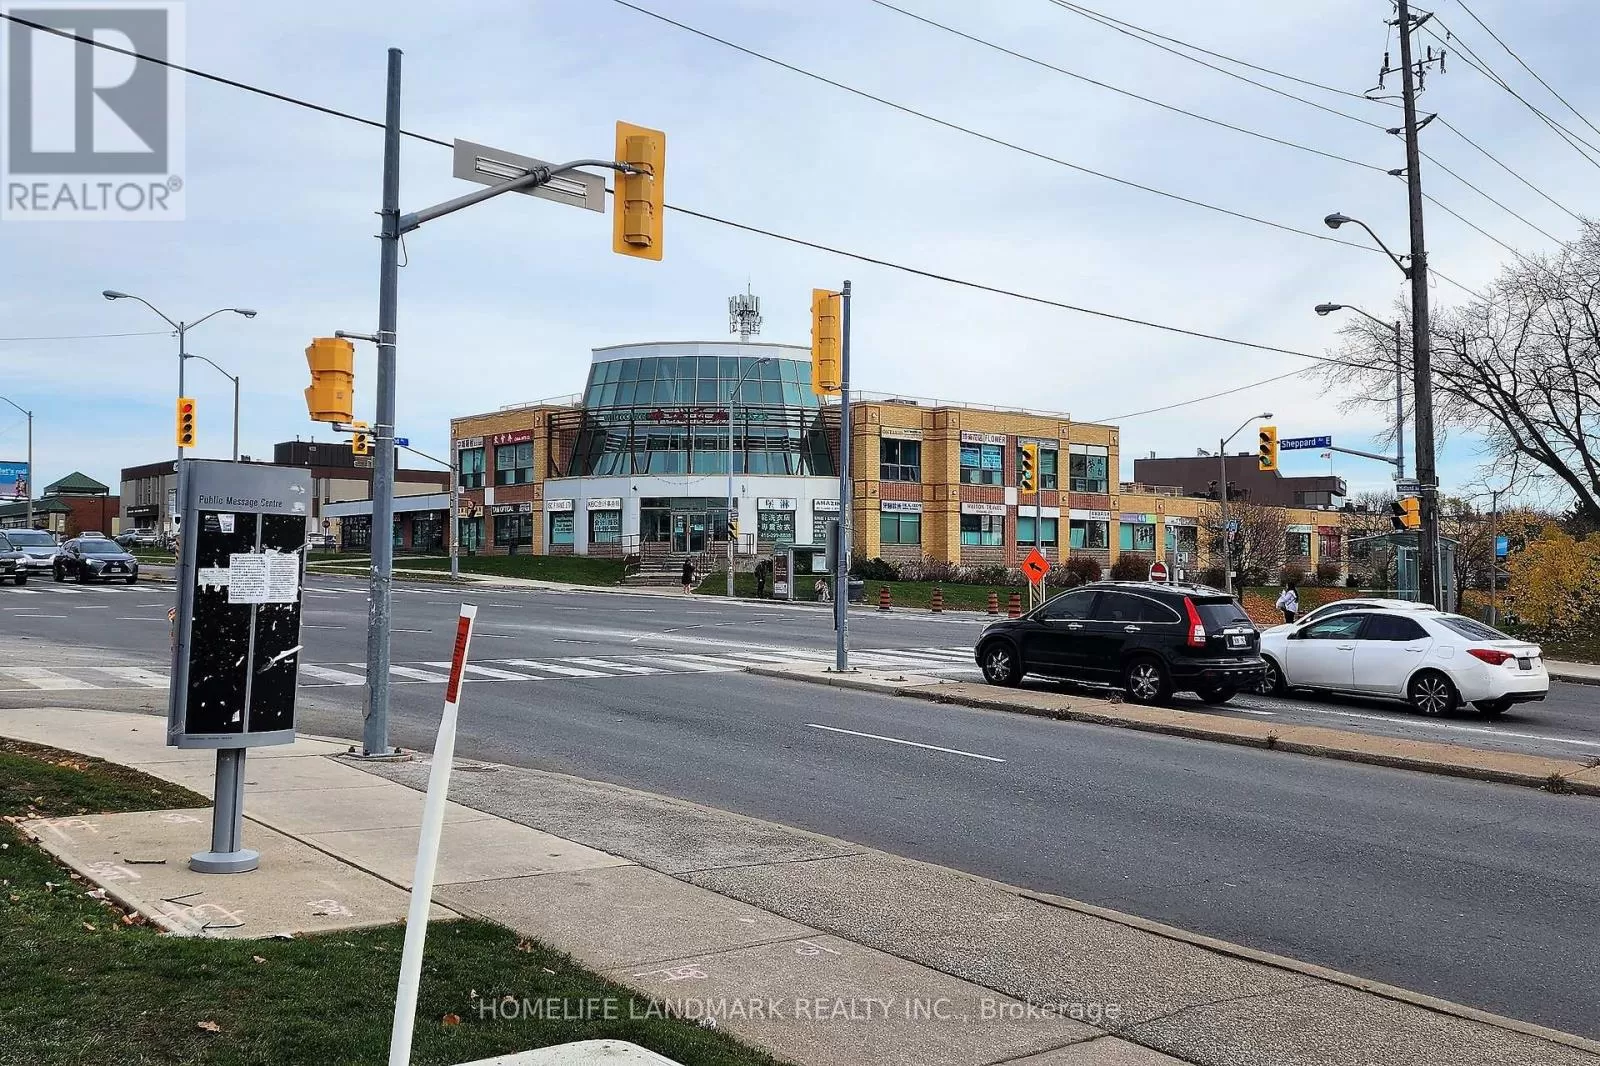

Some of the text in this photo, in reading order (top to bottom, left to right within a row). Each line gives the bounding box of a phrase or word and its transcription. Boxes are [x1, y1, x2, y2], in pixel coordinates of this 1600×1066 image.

[985, 433, 1005, 444] FLOWER
[1281, 438, 1316, 449] Sheppard
[1325, 436, 1331, 445] E
[199, 495, 283, 508] Public Message Centre
